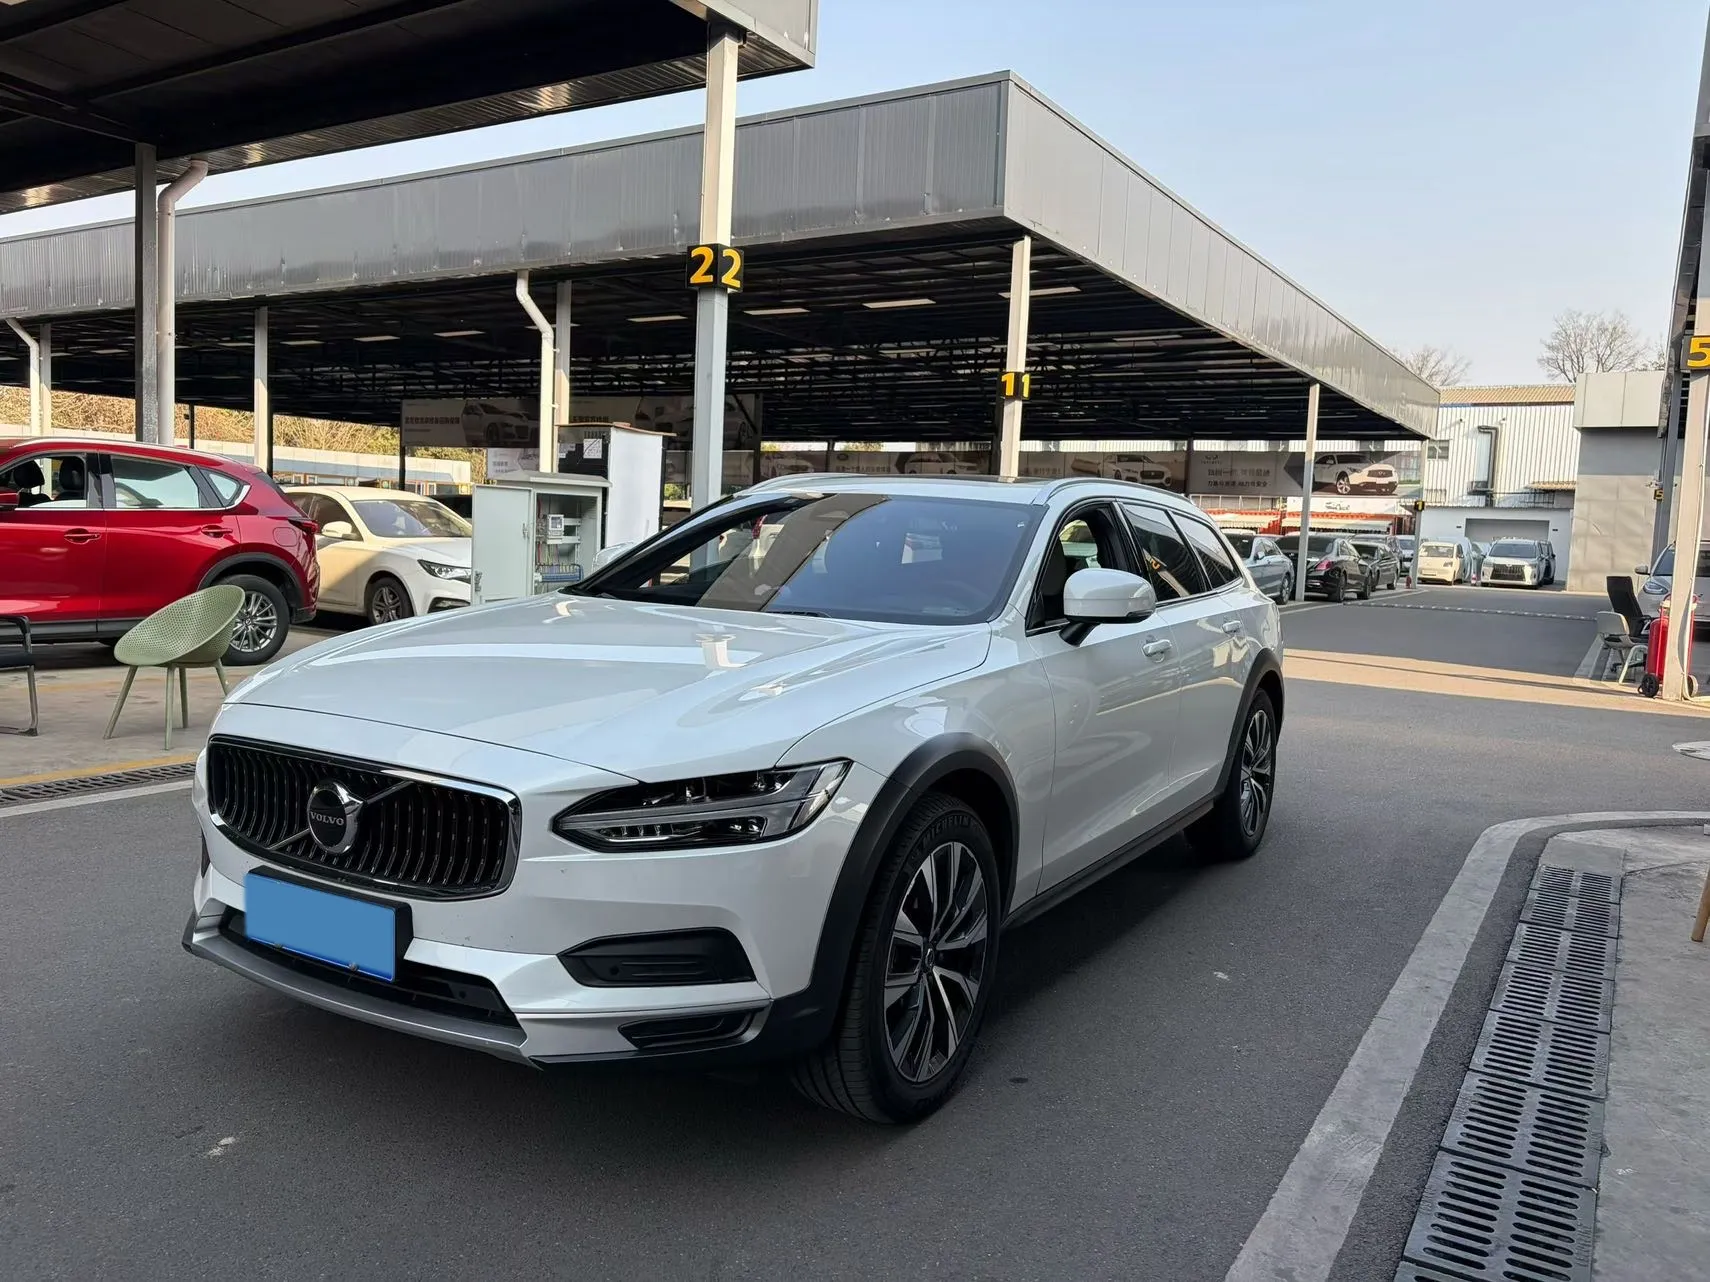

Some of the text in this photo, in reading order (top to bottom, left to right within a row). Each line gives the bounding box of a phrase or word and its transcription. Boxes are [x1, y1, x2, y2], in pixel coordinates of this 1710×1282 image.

[690, 246, 714, 284] 2
[721, 248, 742, 288] 2
[1687, 336, 1710, 368] 5
[1655, 489, 1664, 500] 5
[309, 811, 345, 826] VOLVO
